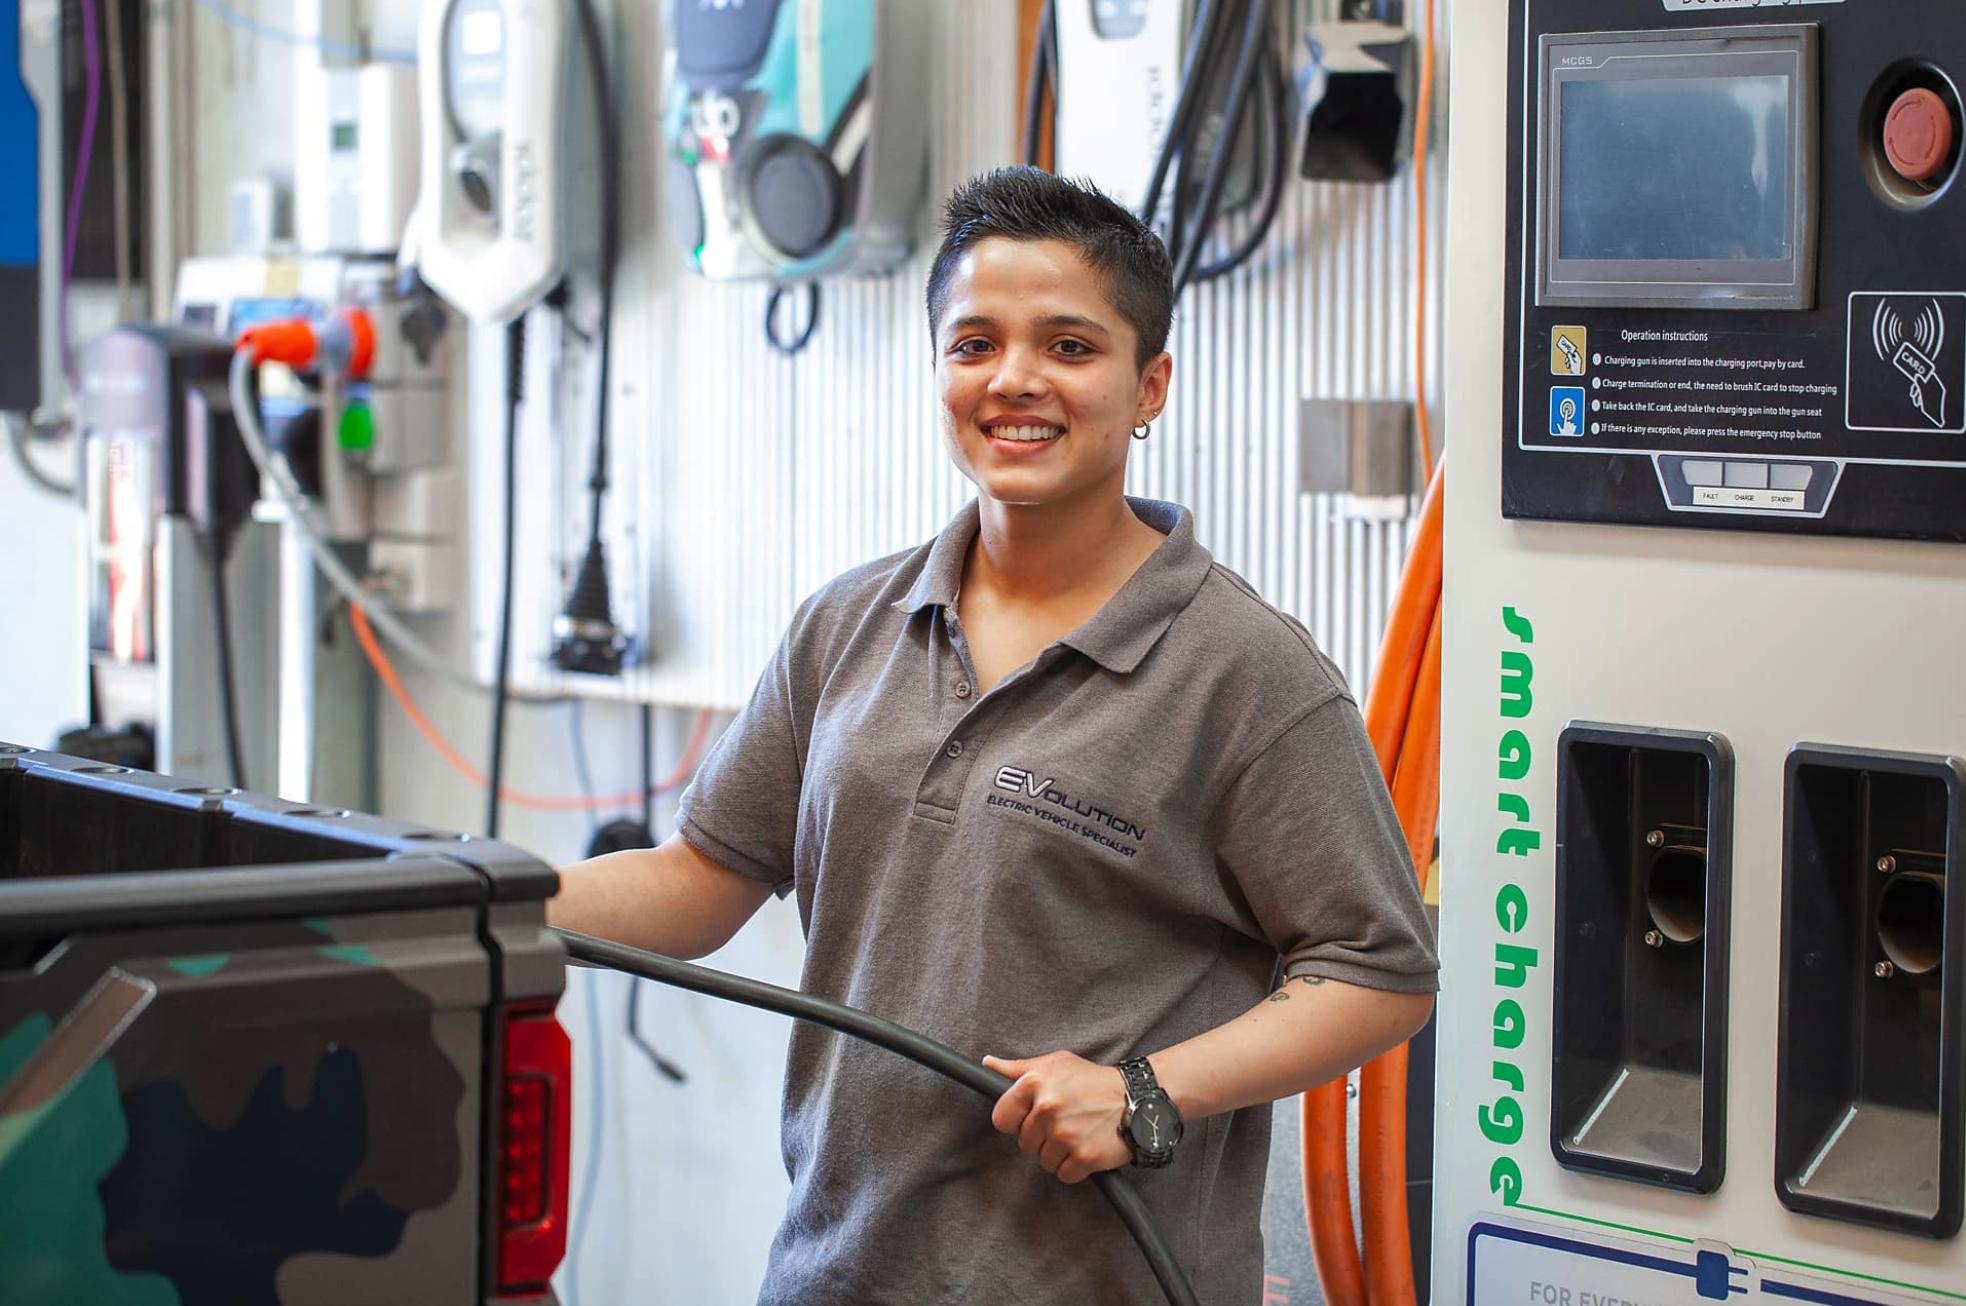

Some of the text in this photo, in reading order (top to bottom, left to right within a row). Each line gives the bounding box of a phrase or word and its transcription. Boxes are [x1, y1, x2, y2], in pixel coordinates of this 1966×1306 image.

[1561, 56, 1593, 66] MCGS
[1621, 329, 1708, 342] Operation instructions
[1604, 356, 1635, 367] Charging
[1637, 359, 1651, 367] gun
[1652, 357, 1657, 365] is
[1658, 357, 1686, 366] inserted
[1687, 357, 1702, 366] into
[1703, 357, 1714, 366] the
[1715, 358, 1745, 369] charging
[1777, 359, 1786, 370] by
[1901, 351, 1926, 374] CARD
[1602, 379, 1627, 390] Charge
[1628, 380, 1668, 388] termination
[1693, 381, 1705, 389] the
[1706, 382, 1723, 390] need
[1733, 382, 1753, 391] brush
[1754, 383, 1762, 391] IC
[1762, 383, 1778, 391] card
[1788, 385, 1804, 394] stop
[1805, 384, 1837, 395] charging
[1602, 401, 1616, 410] Take
[1618, 402, 1634, 410] back
[1635, 402, 1646, 411] the
[1647, 403, 1655, 411] IC
[1673, 403, 1687, 412] and
[1688, 404, 1703, 412] take
[1704, 404, 1715, 413] the
[1716, 405, 1747, 416] charging
[1748, 407, 1762, 416] gun
[1762, 406, 1777, 415] into
[1778, 406, 1790, 415] the
[1791, 409, 1805, 417] gun
[1806, 408, 1822, 416] seat
[1601, 423, 1608, 431] If
[1608, 424, 1626, 432] there
[1627, 424, 1633, 432] is
[1634, 426, 1646, 435] any
[1683, 426, 1706, 436] please
[1707, 428, 1725, 437] press
[1726, 427, 1738, 436] the
[1739, 430, 1778, 440] emergency
[1779, 430, 1795, 440] stop
[1796, 429, 1821, 439] button
[986, 793, 1137, 858] ELECTRIC VEHICLE SPECIALIST
[1478, 606, 1541, 1206] smart charge
[1530, 1281, 1571, 1306] FOR
